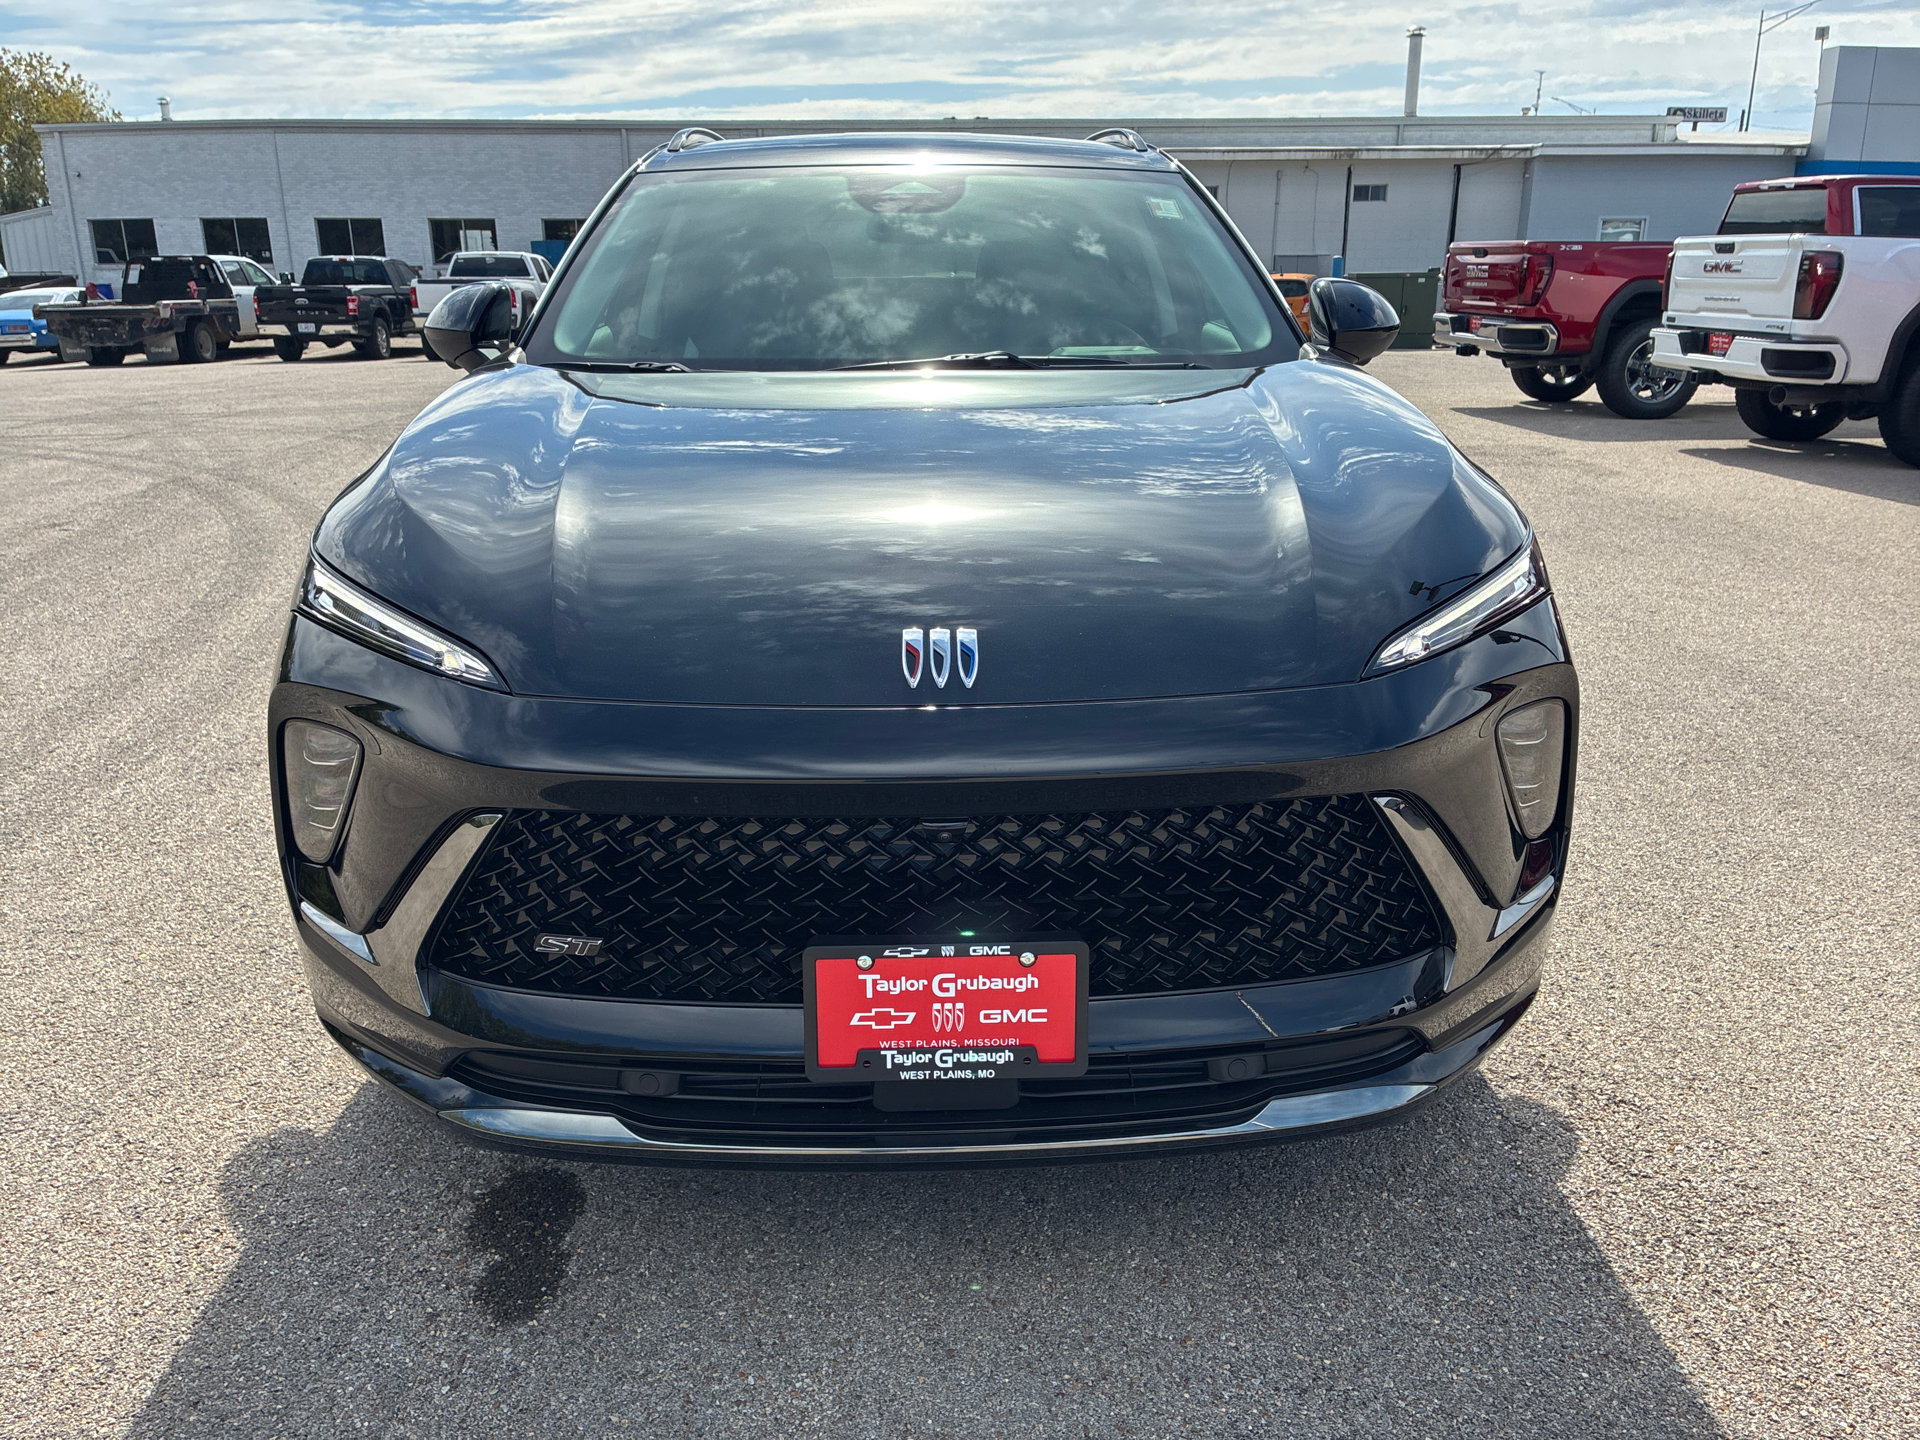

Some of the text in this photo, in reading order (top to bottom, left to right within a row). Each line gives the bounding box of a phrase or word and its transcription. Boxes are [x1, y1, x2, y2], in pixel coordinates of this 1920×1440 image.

[1686, 107, 1724, 119] Skillets
[1703, 260, 1744, 273] GMC
[535, 936, 603, 956] ST
[969, 945, 1011, 956] GMC
[858, 973, 1039, 998] Taylor Grubaugh
[979, 1008, 1048, 1024] GMC
[879, 1037, 1020, 1049] WEST PLAINS, MISSOURI
[880, 1049, 1014, 1069] Taylor Grubaugh
[900, 1069, 995, 1080] WEST PLAINS, MO
